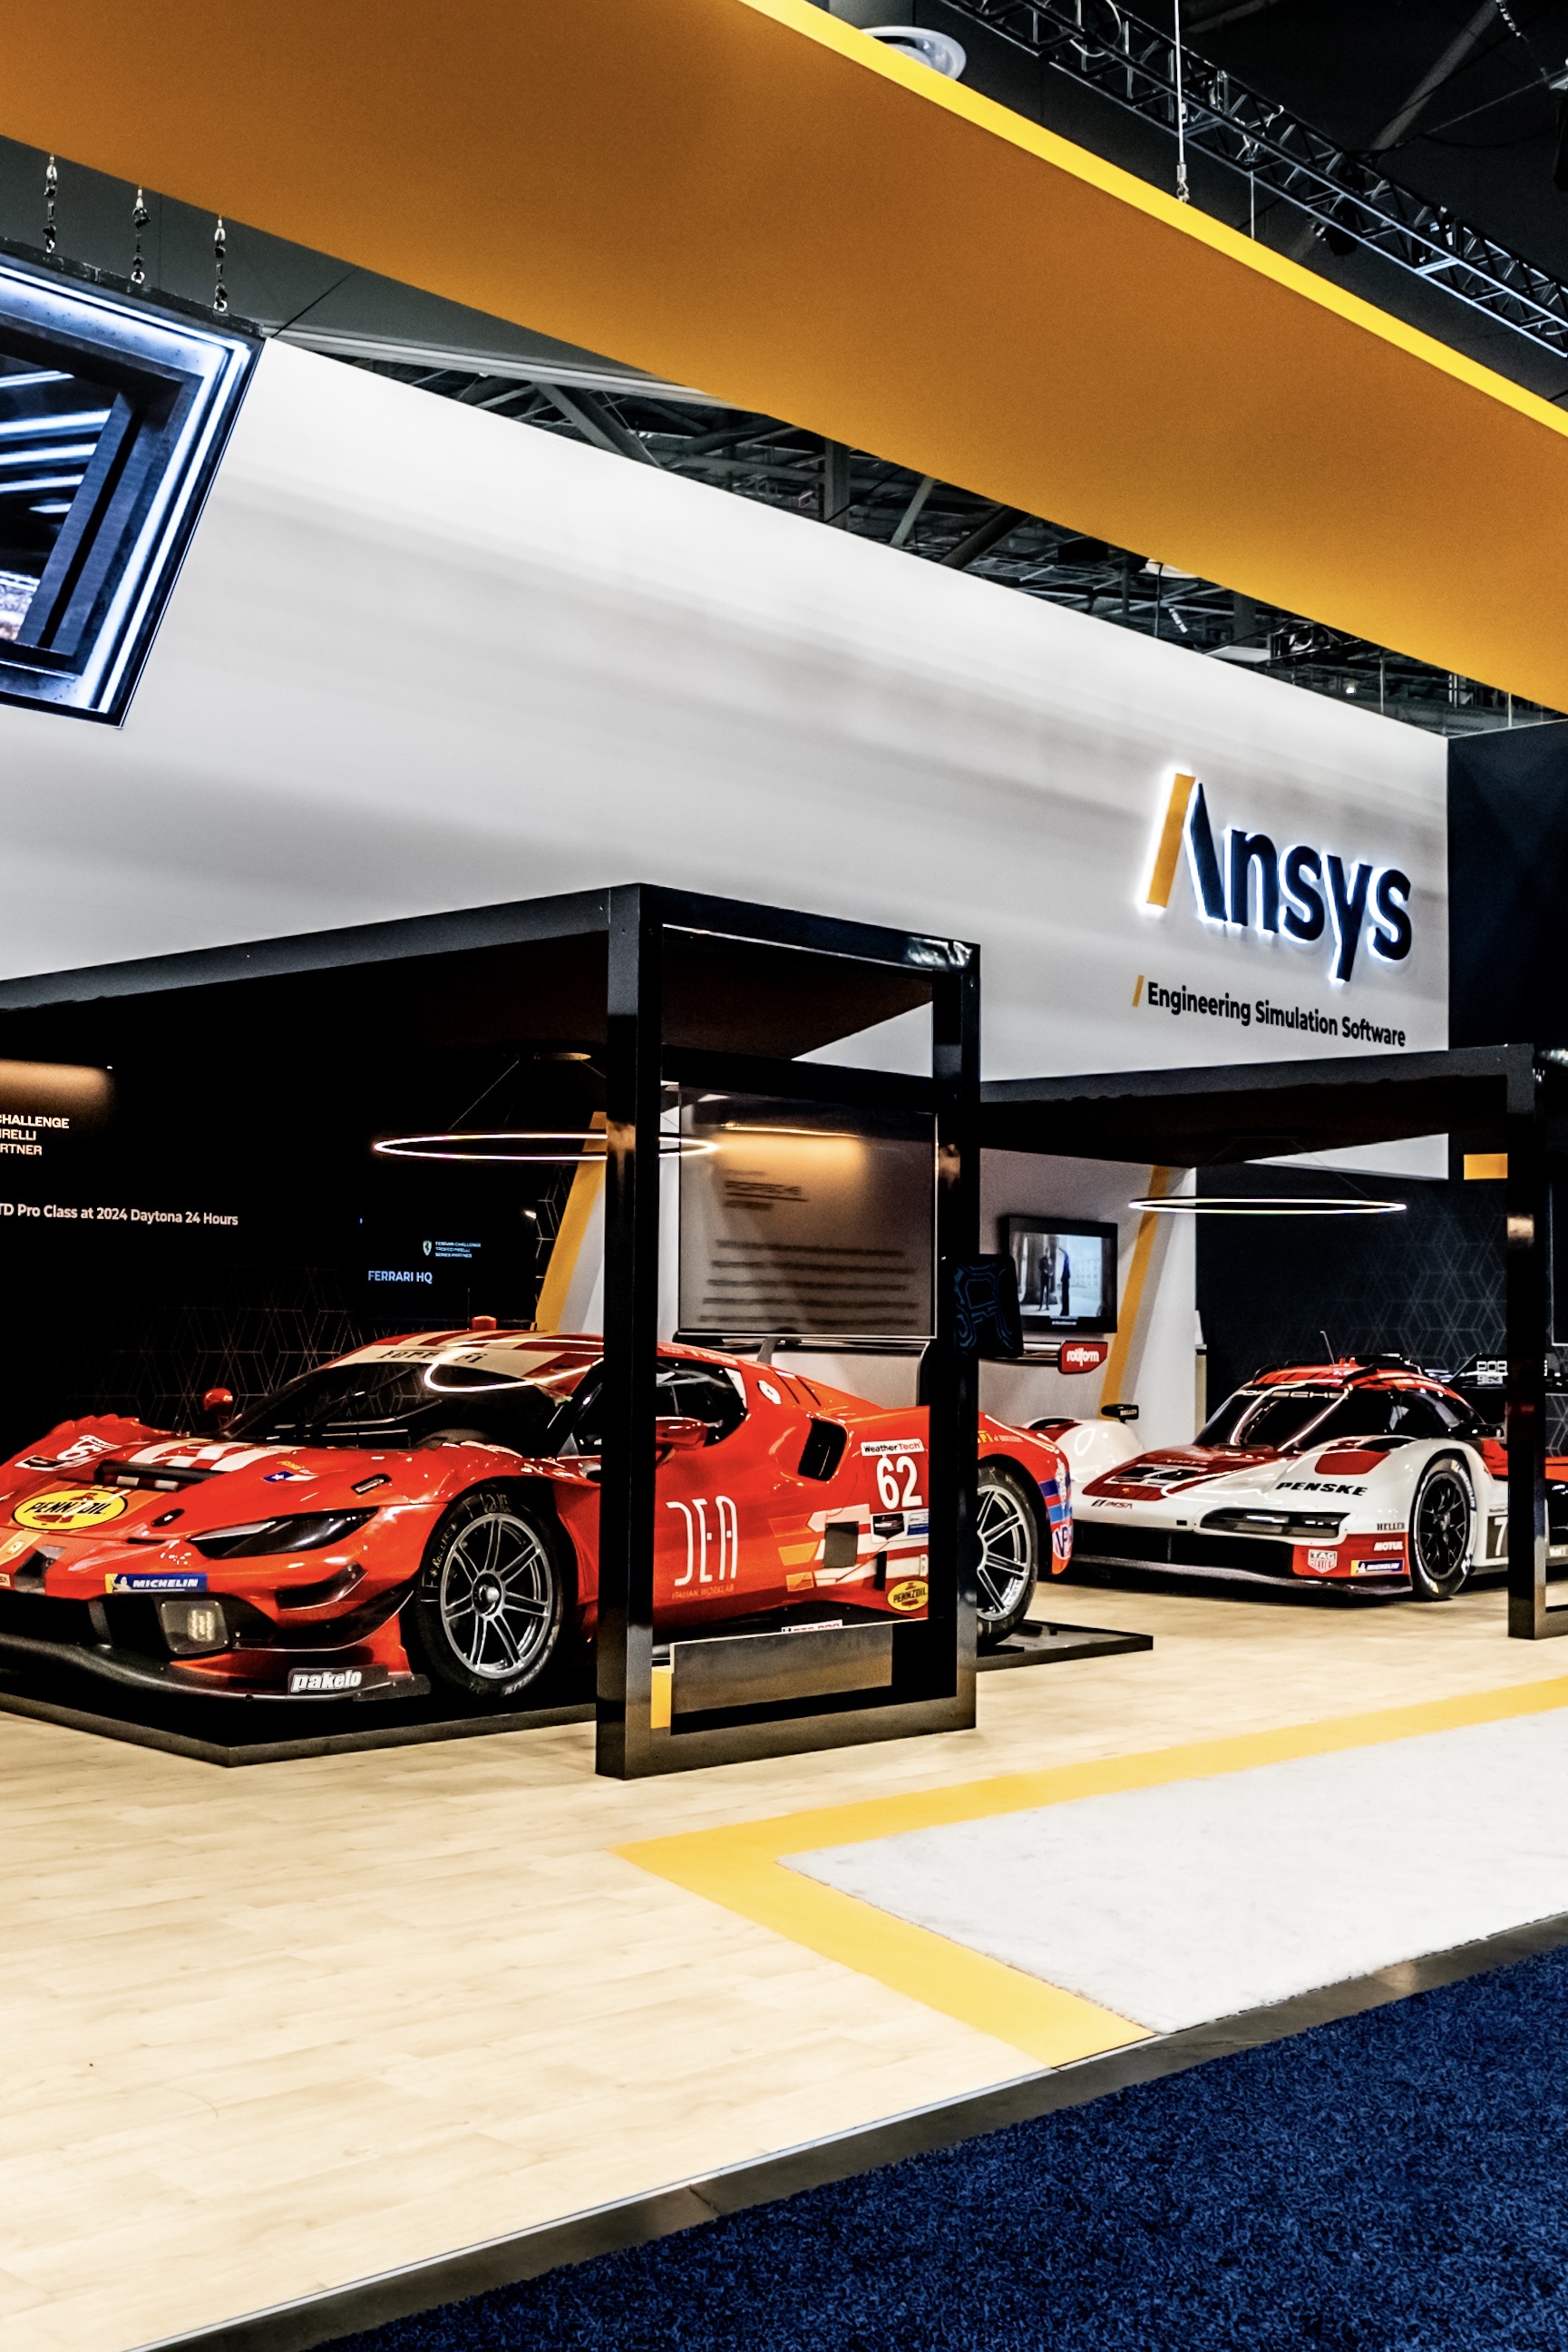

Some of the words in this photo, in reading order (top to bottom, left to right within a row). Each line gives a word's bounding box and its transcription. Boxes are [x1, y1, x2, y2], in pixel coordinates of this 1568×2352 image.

[1145, 773, 1412, 981] Ansys
[1147, 981, 1251, 1027] Engineering
[1255, 1000, 1338, 1036] Simulation
[1341, 1016, 1407, 1047] Software
[0, 1114, 70, 1129] HALLENGE
[17, 1203, 41, 1217] Pro
[44, 1204, 78, 1219] Class
[81, 1207, 94, 1219] at
[96, 1206, 128, 1221] 2024
[131, 1208, 183, 1225] Daytona
[185, 1211, 201, 1224] 24
[203, 1212, 239, 1226] Hours
[367, 1270, 414, 1283] FERRARI
[416, 1271, 433, 1284] HQ
[876, 1455, 923, 1509] 62
[1275, 1481, 1368, 1497] PENSKE
[1374, 1540, 1404, 1552] MOTUL
[1494, 1516, 1508, 1557] 7
[1311, 1551, 1336, 1560] TAG
[132, 1578, 200, 1588] MICHELIN
[290, 1669, 363, 1693] pakelo
